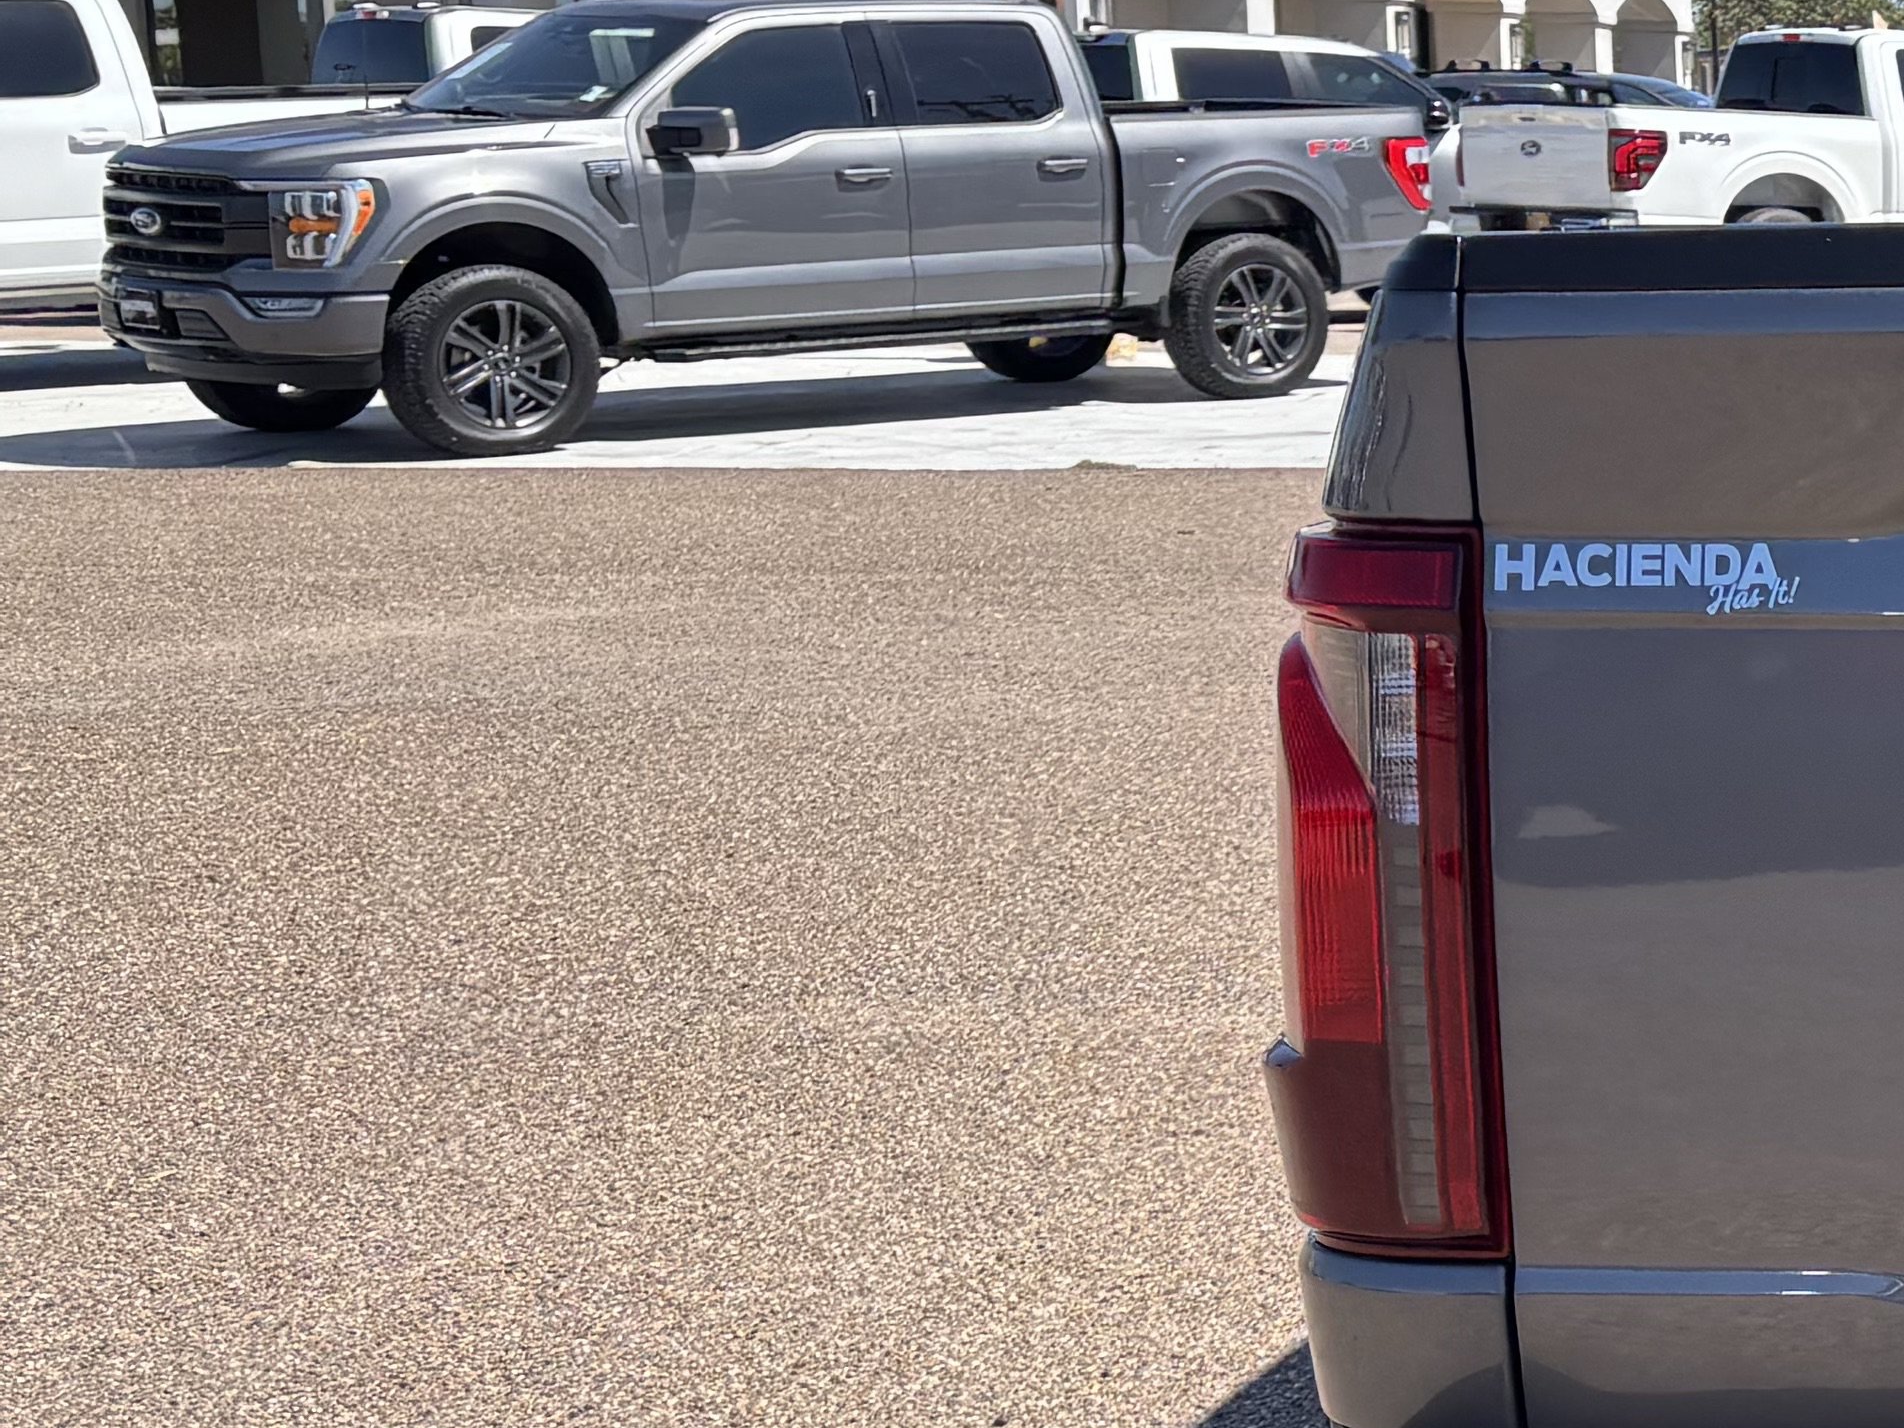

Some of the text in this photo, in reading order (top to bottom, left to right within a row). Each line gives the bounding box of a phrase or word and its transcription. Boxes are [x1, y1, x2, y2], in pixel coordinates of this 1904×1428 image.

[1679, 131, 1731, 146] FX4
[1494, 542, 1779, 591] HACIENDA
[1706, 576, 1801, 616] Has It!
